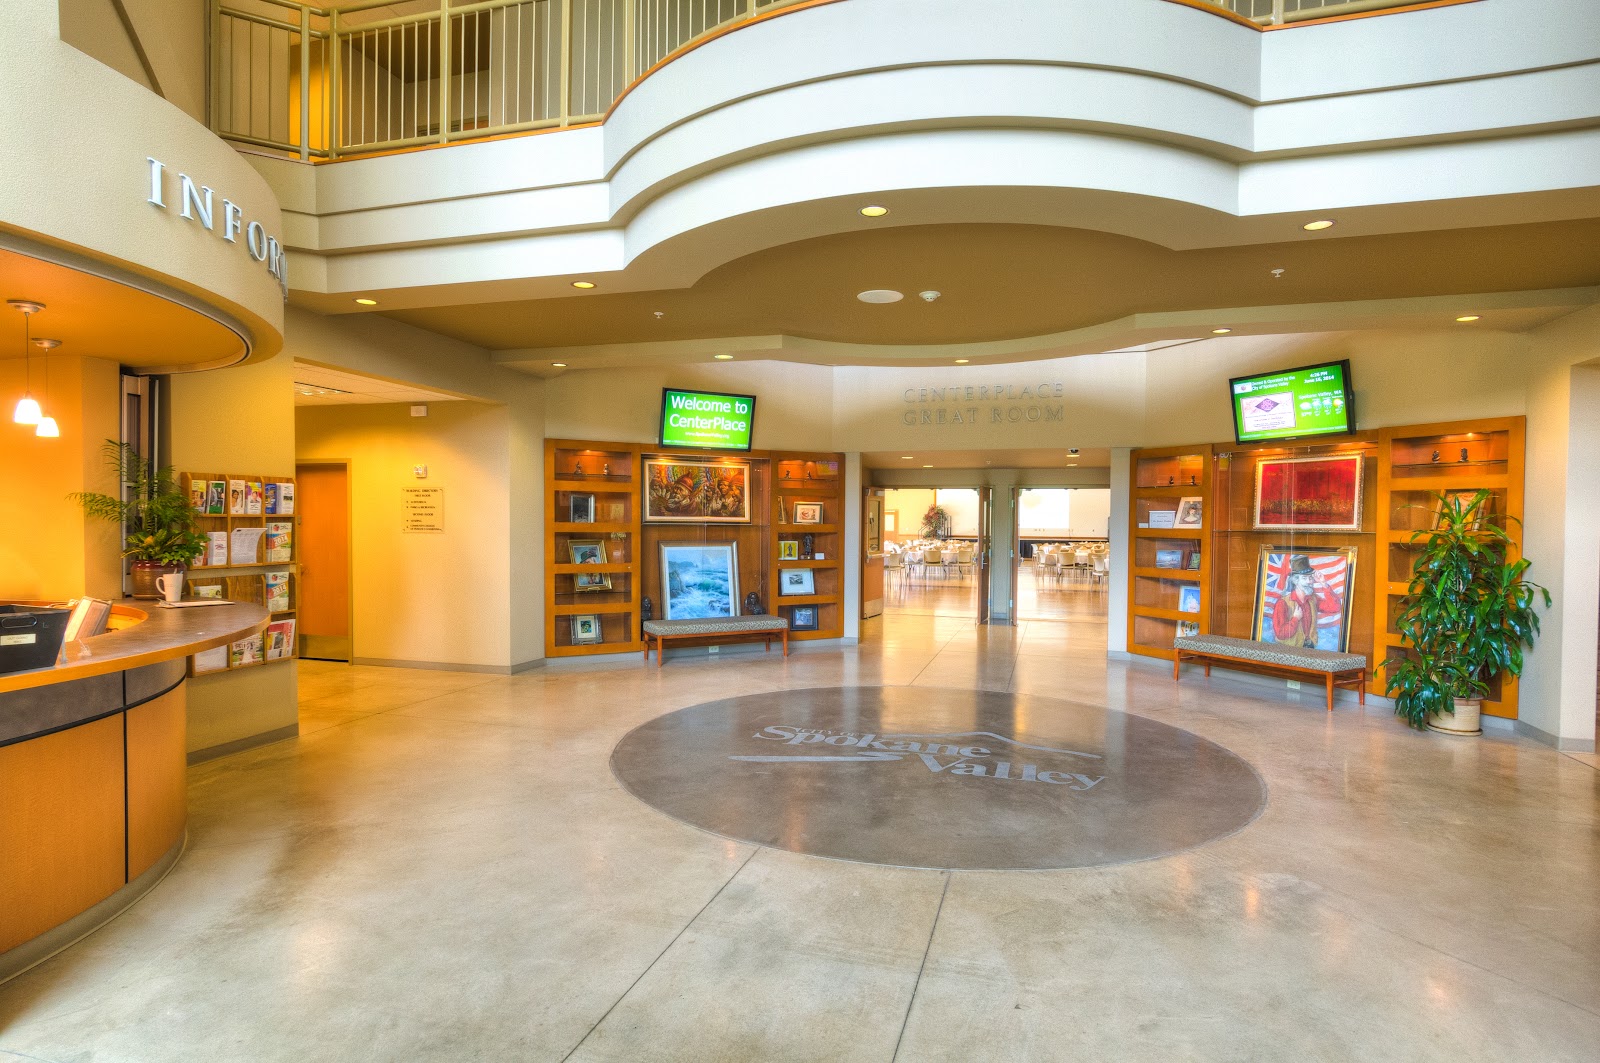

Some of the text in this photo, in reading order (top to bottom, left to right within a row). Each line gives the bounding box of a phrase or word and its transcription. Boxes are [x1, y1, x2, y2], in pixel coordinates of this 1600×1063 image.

[903, 381, 1064, 404] CENTERPLACE
[671, 395, 748, 414] Welcome to
[902, 404, 1064, 426] GREAT ROOM
[669, 413, 746, 432] CenterPlace
[752, 725, 992, 759] Spokane
[917, 752, 1109, 791] Valley
